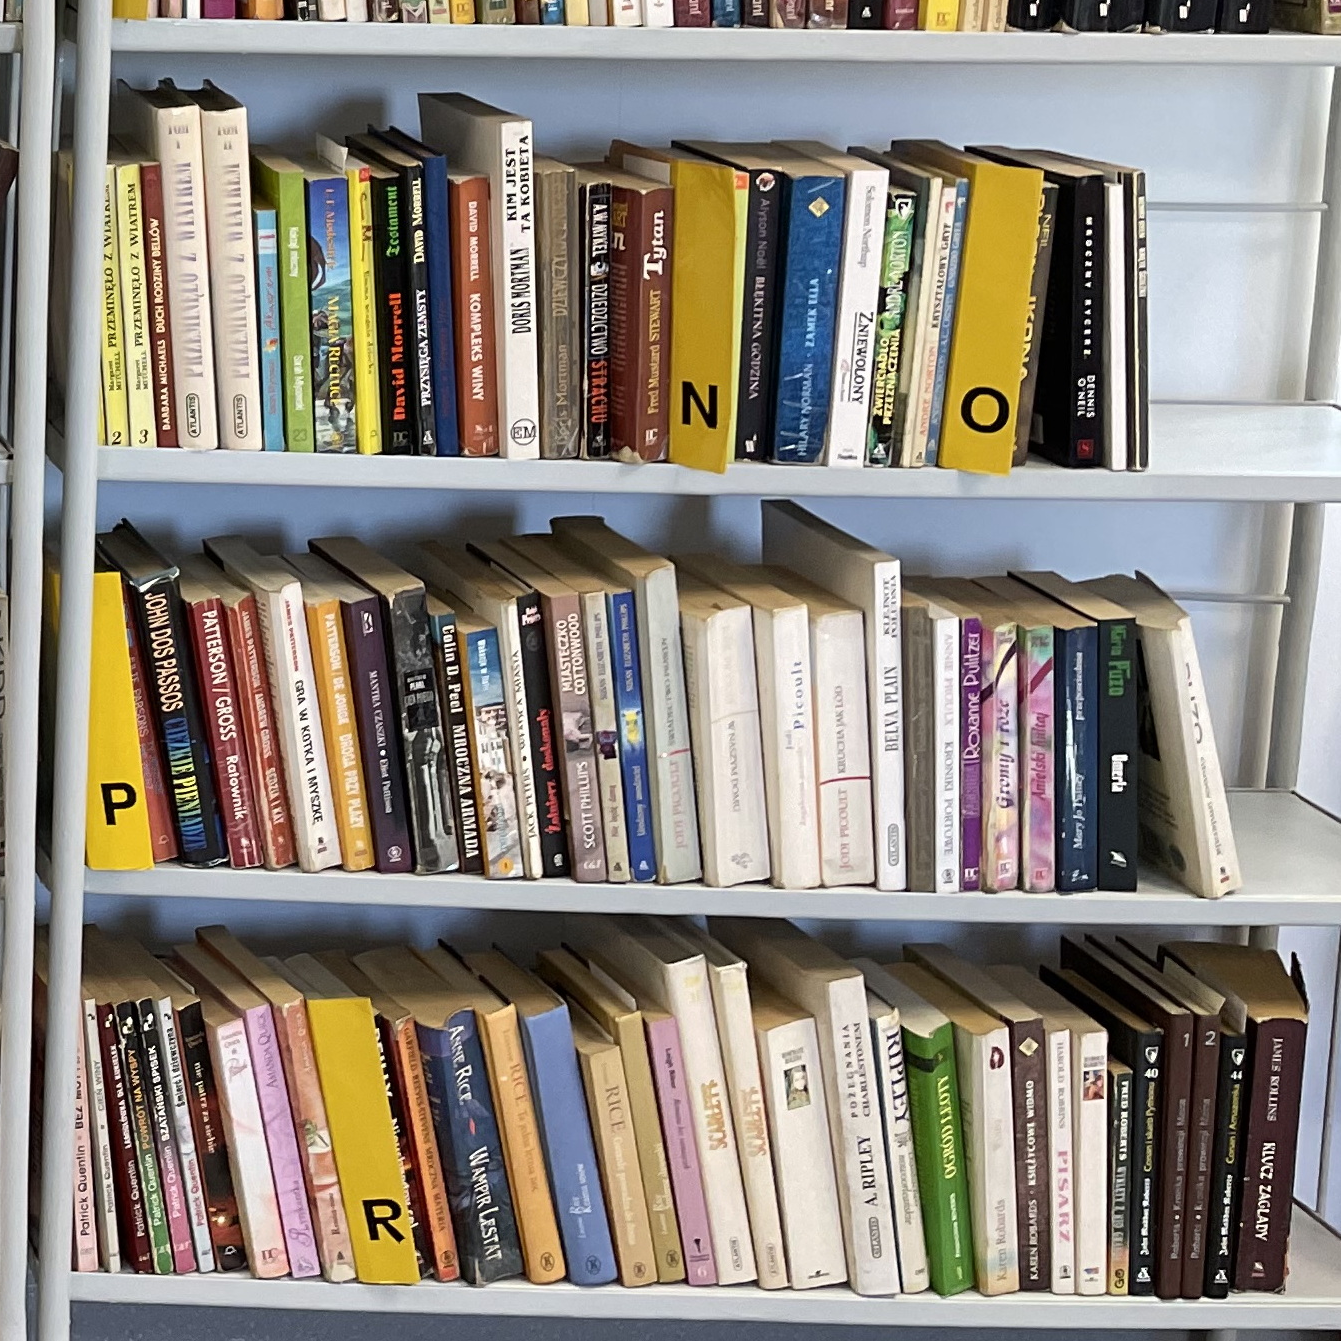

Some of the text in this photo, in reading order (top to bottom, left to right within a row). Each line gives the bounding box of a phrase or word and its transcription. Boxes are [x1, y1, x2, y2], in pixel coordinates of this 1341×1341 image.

[505, 147, 517, 221] KIM JEST
[519, 134, 531, 233] TA KOBIETA
[641, 210, 665, 280] Tytan
[386, 186, 406, 421] David Morrell Testament
[469, 293, 484, 401] KOMPLEKS WINY
[681, 382, 717, 428] N
[961, 386, 1010, 434] O
[555, 619, 571, 692] MIASTECZKO
[569, 612, 585, 695] COTTONWOOD
[790, 659, 805, 732] Picoult
[884, 666, 899, 752] BELVA PLAIN
[101, 782, 137, 825] P
[453, 724, 479, 859] MROCZNA ARMADA
[364, 1199, 406, 1243] R
